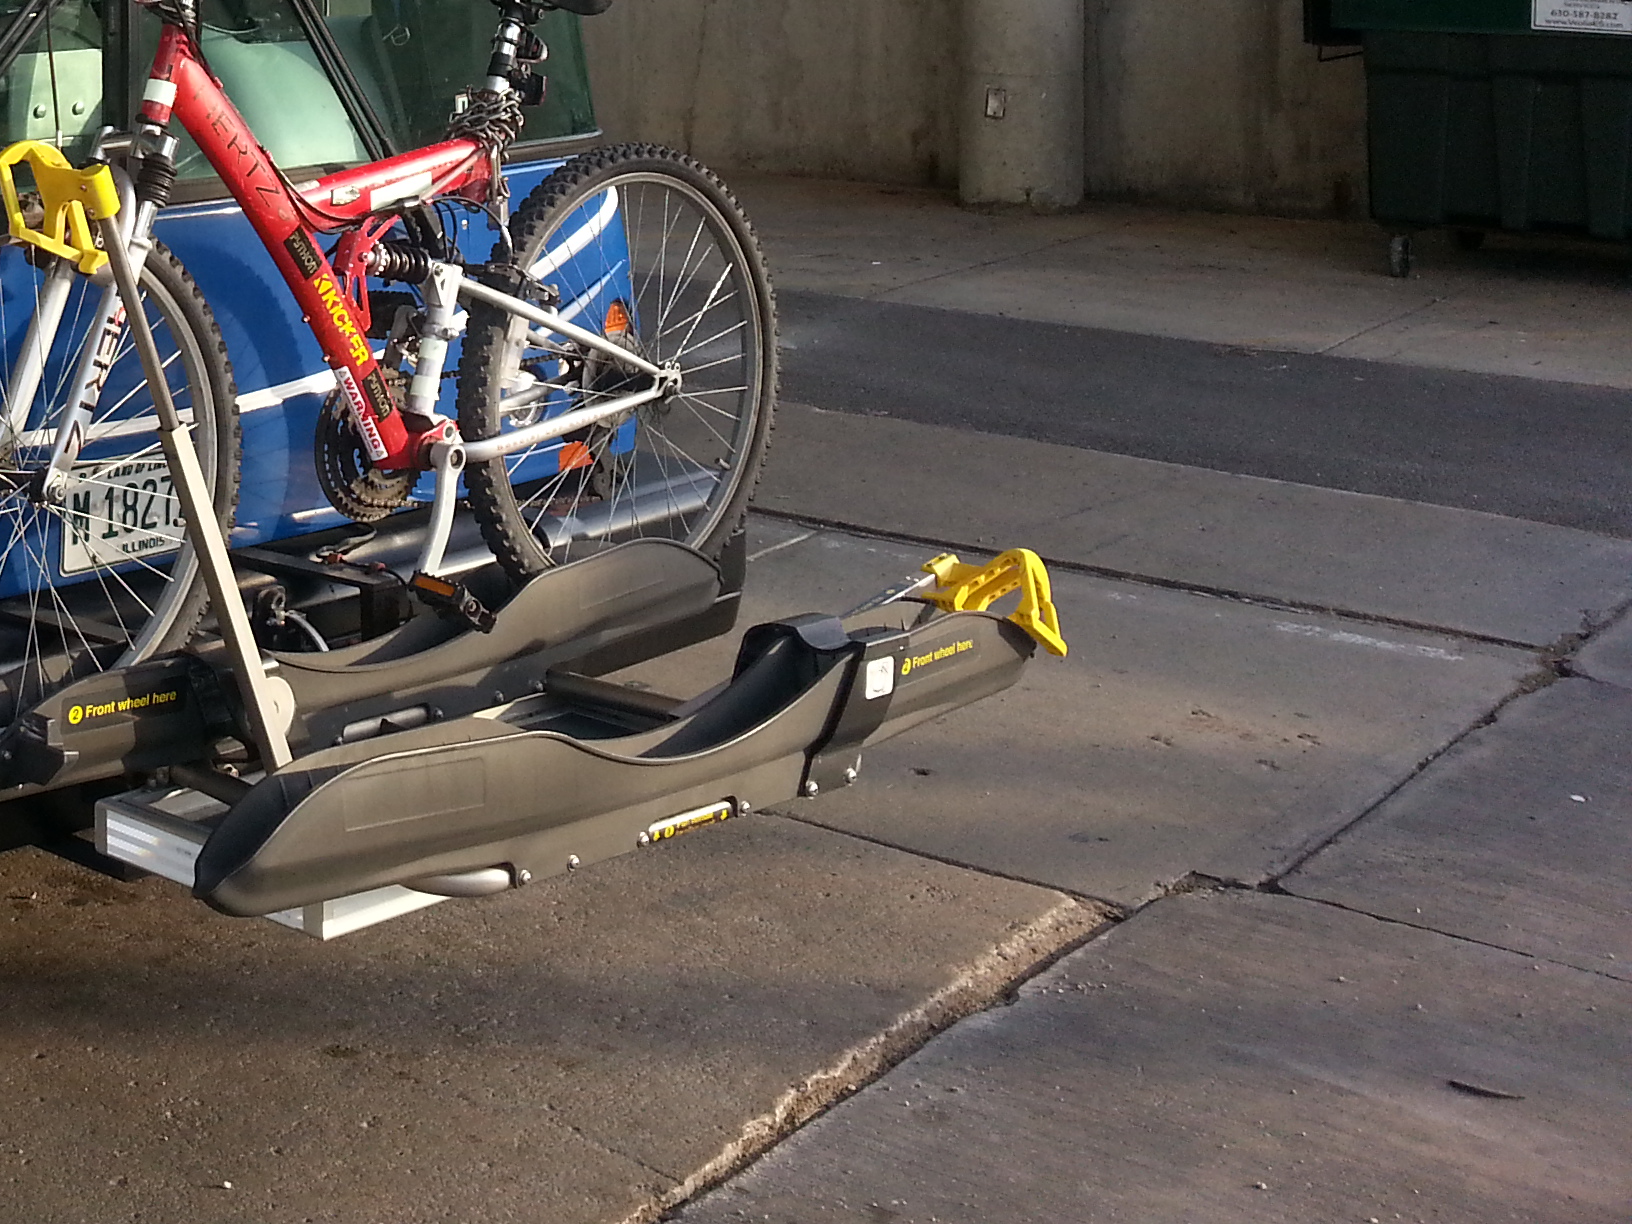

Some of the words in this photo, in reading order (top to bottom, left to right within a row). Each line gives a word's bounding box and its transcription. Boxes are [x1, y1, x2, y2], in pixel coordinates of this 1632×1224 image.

[322, 284, 369, 367] KICKER
[342, 376, 381, 450] WARNING
[102, 475, 183, 539] 1827
[122, 536, 165, 553] ILLINOIS
[85, 700, 115, 718] Front
[118, 693, 150, 712] wheel
[152, 691, 177, 704] here
